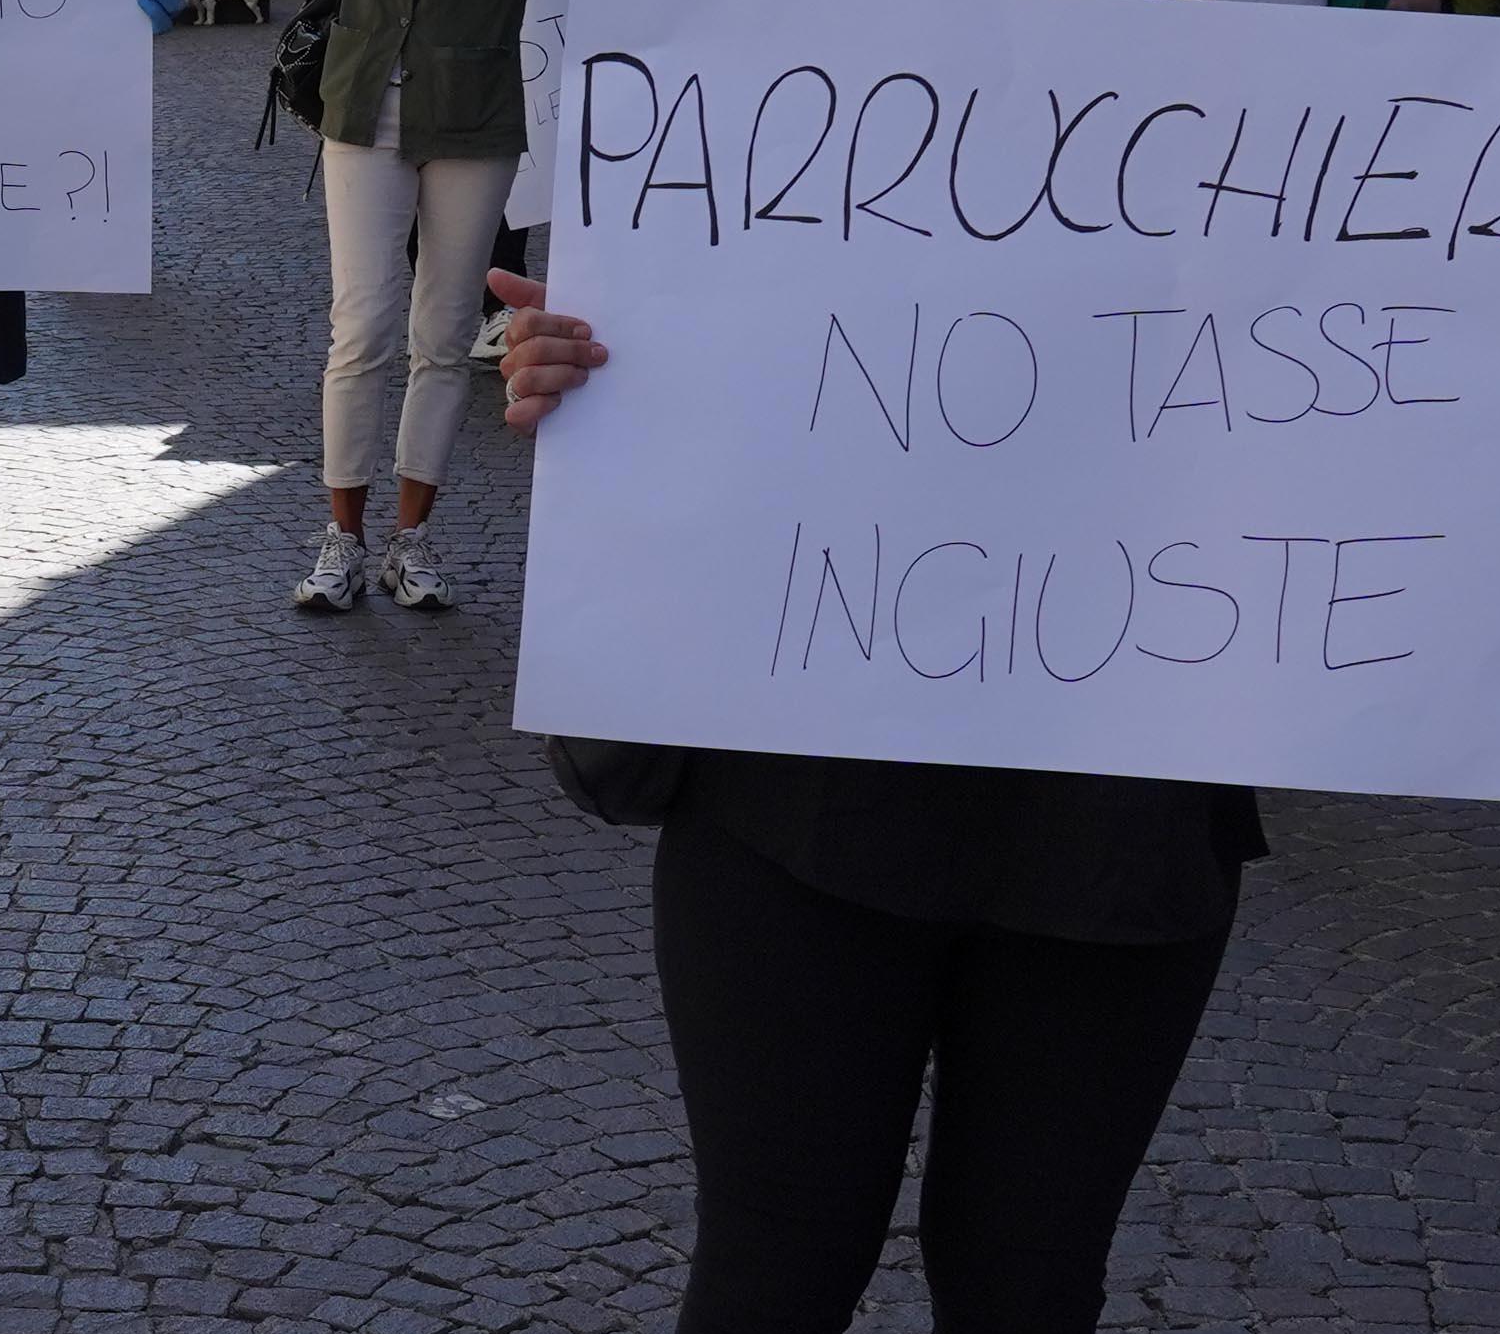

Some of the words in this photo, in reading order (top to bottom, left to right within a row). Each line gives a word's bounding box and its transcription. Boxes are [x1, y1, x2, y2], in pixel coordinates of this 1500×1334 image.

[809, 302, 1039, 453] NO
[1092, 302, 1463, 443] TASSE
[770, 522, 1447, 685] INGIUSTE
